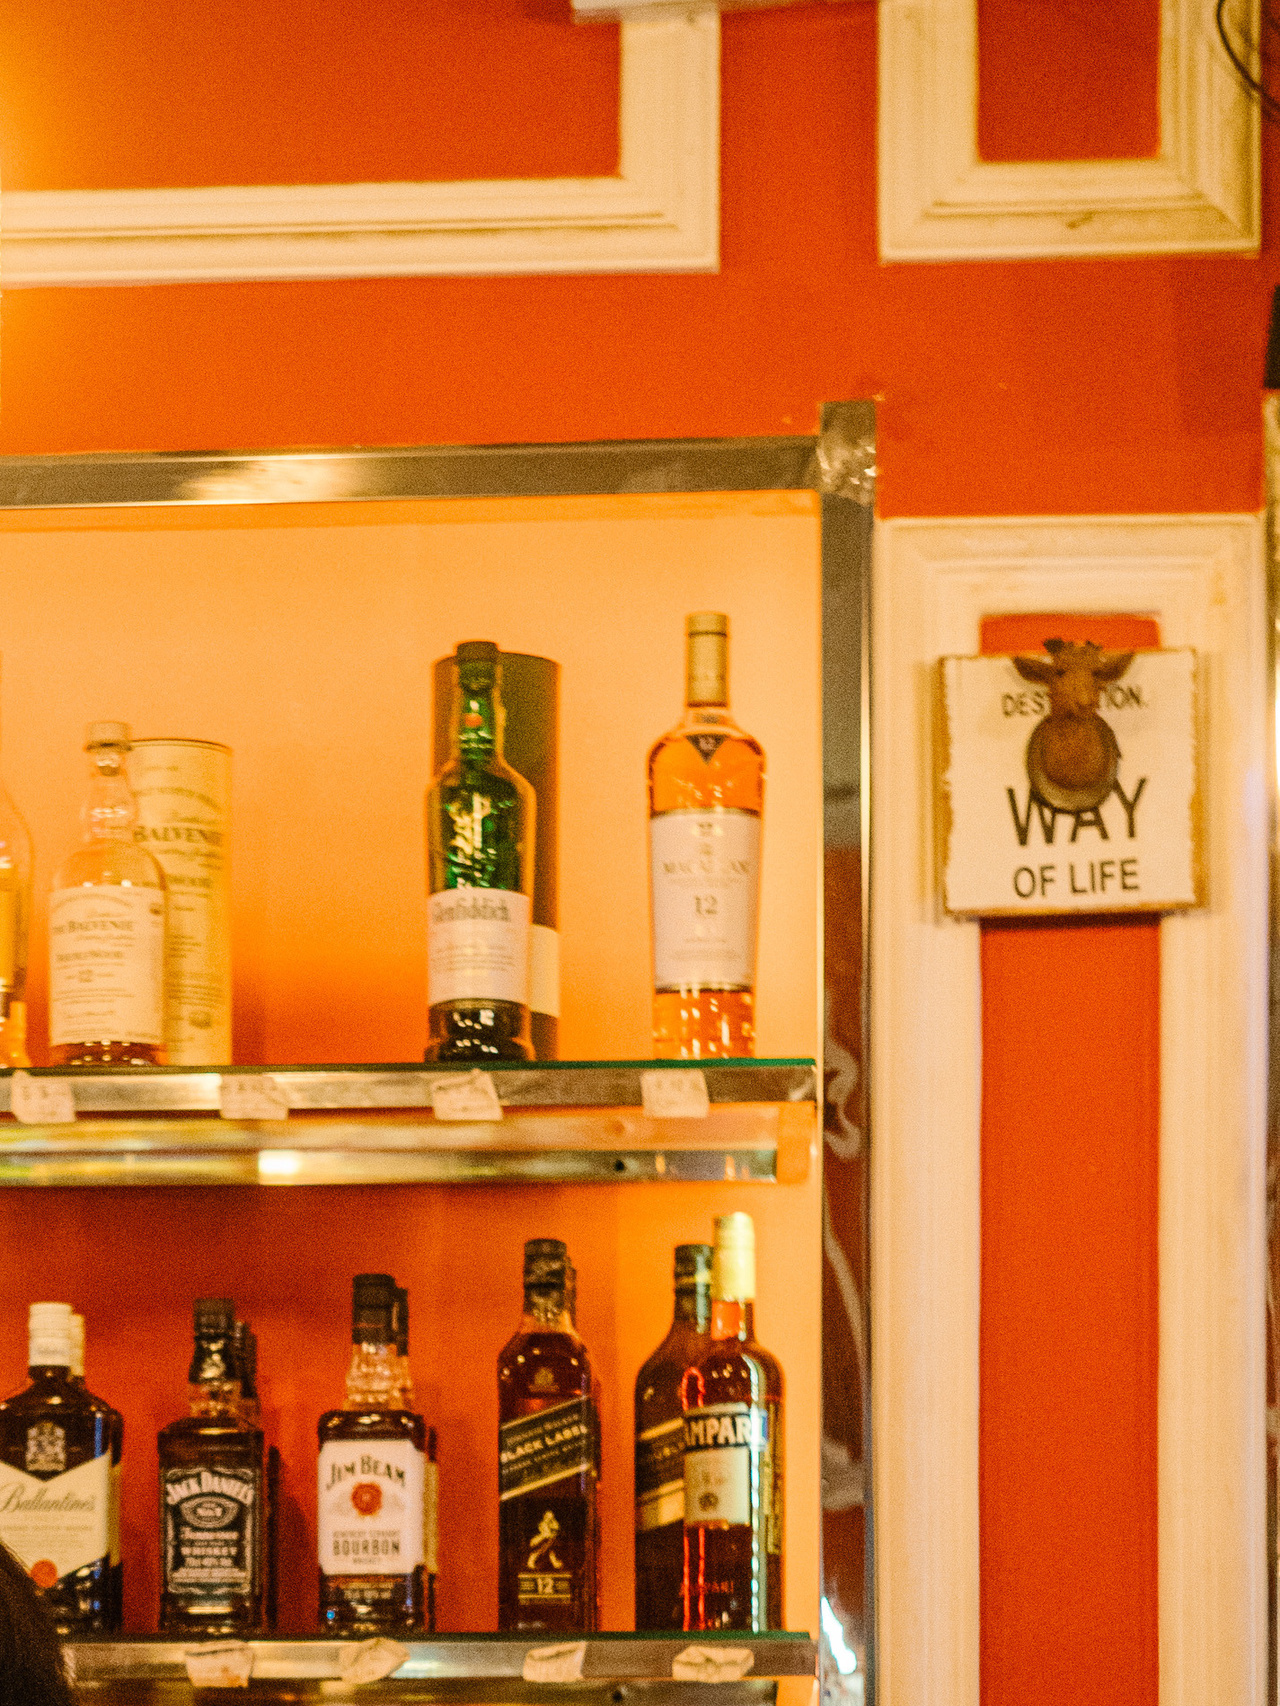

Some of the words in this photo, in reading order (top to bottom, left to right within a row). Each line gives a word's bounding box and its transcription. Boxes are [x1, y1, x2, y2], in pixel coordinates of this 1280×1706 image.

[1002, 683, 1149, 717] DESION.
[1006, 777, 1147, 846] WAY
[1013, 865, 1055, 899] OF
[1069, 858, 1140, 895] LIFE
[694, 894, 718, 915] 12
[326, 1462, 356, 1490] JIM
[360, 1455, 406, 1487] BEAM
[333, 1539, 400, 1556] BOURBON
